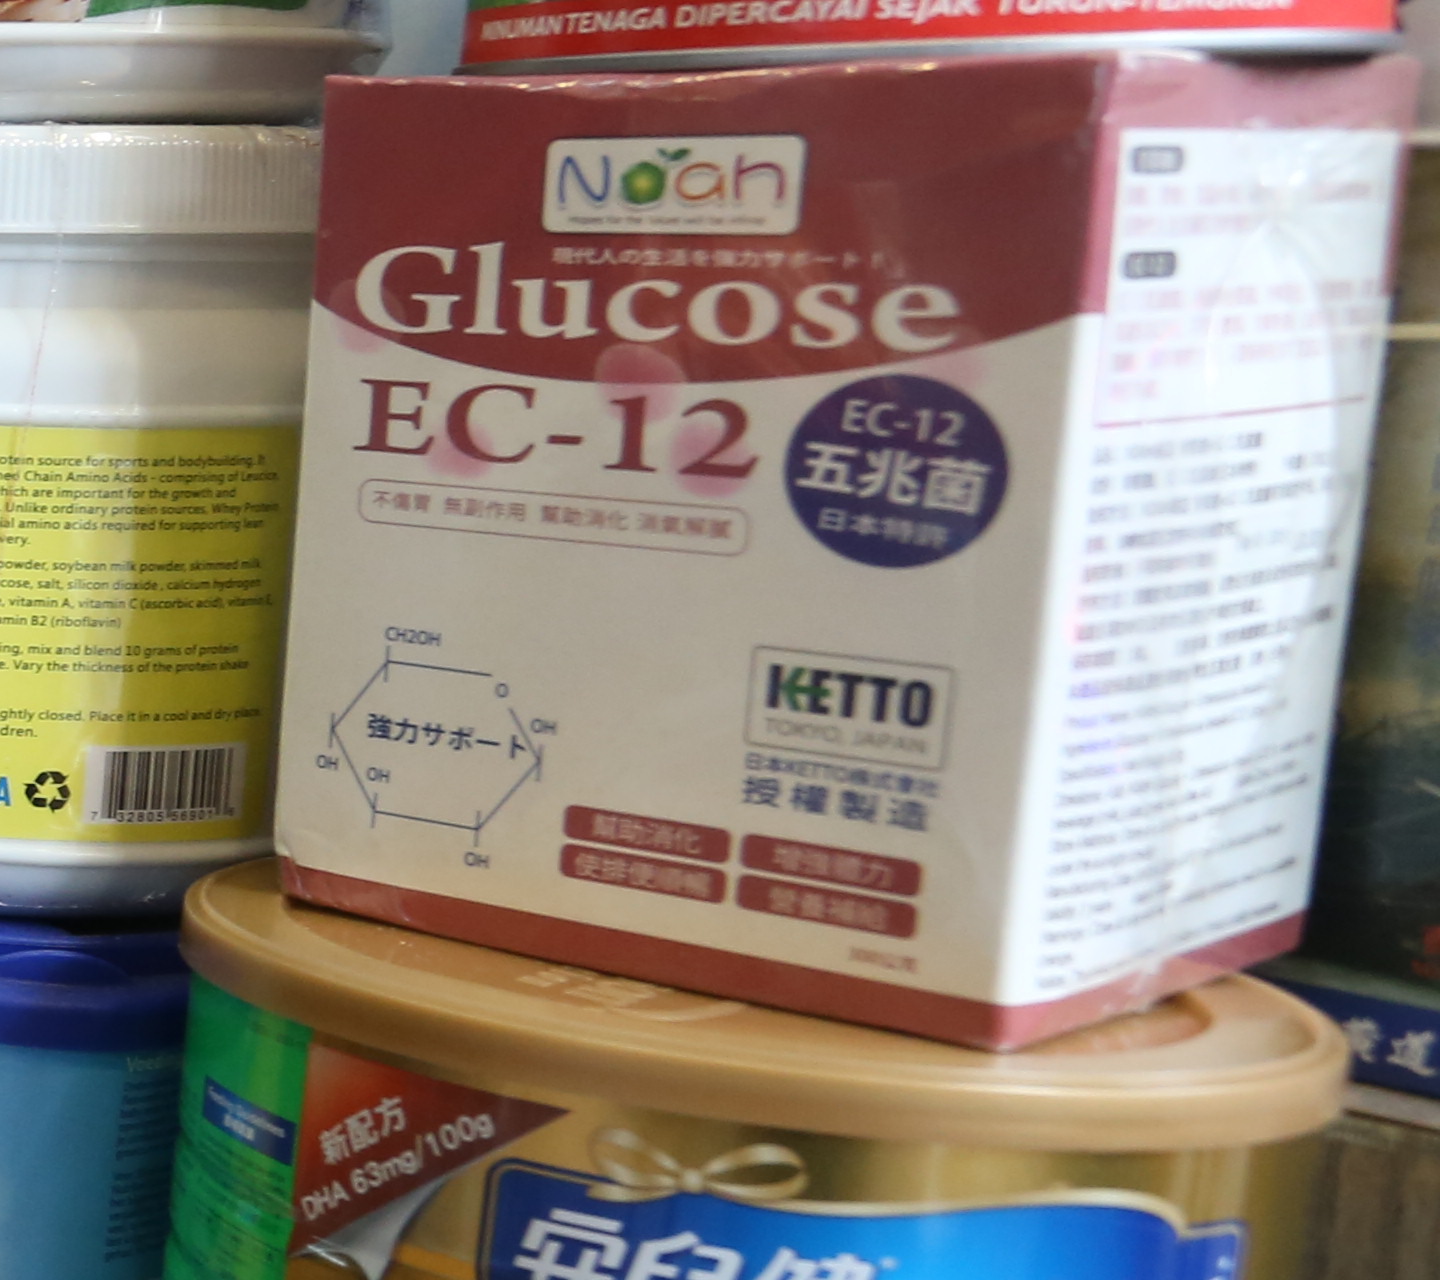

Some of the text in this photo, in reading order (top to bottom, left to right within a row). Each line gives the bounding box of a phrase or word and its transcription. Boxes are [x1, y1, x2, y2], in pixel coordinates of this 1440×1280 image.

[565, 6, 668, 35] TENAGA
[554, 146, 788, 212] Noah
[352, 241, 962, 355] Glucose
[352, 376, 760, 482] EC-12
[840, 398, 967, 449] EC-12
[795, 443, 994, 516] 五兆菌
[765, 662, 934, 735] KETTO
[366, 711, 526, 764] 強力サポート
[299, 1108, 496, 1223] DHA 63mg/100g
[317, 1095, 409, 1166] 新配方
